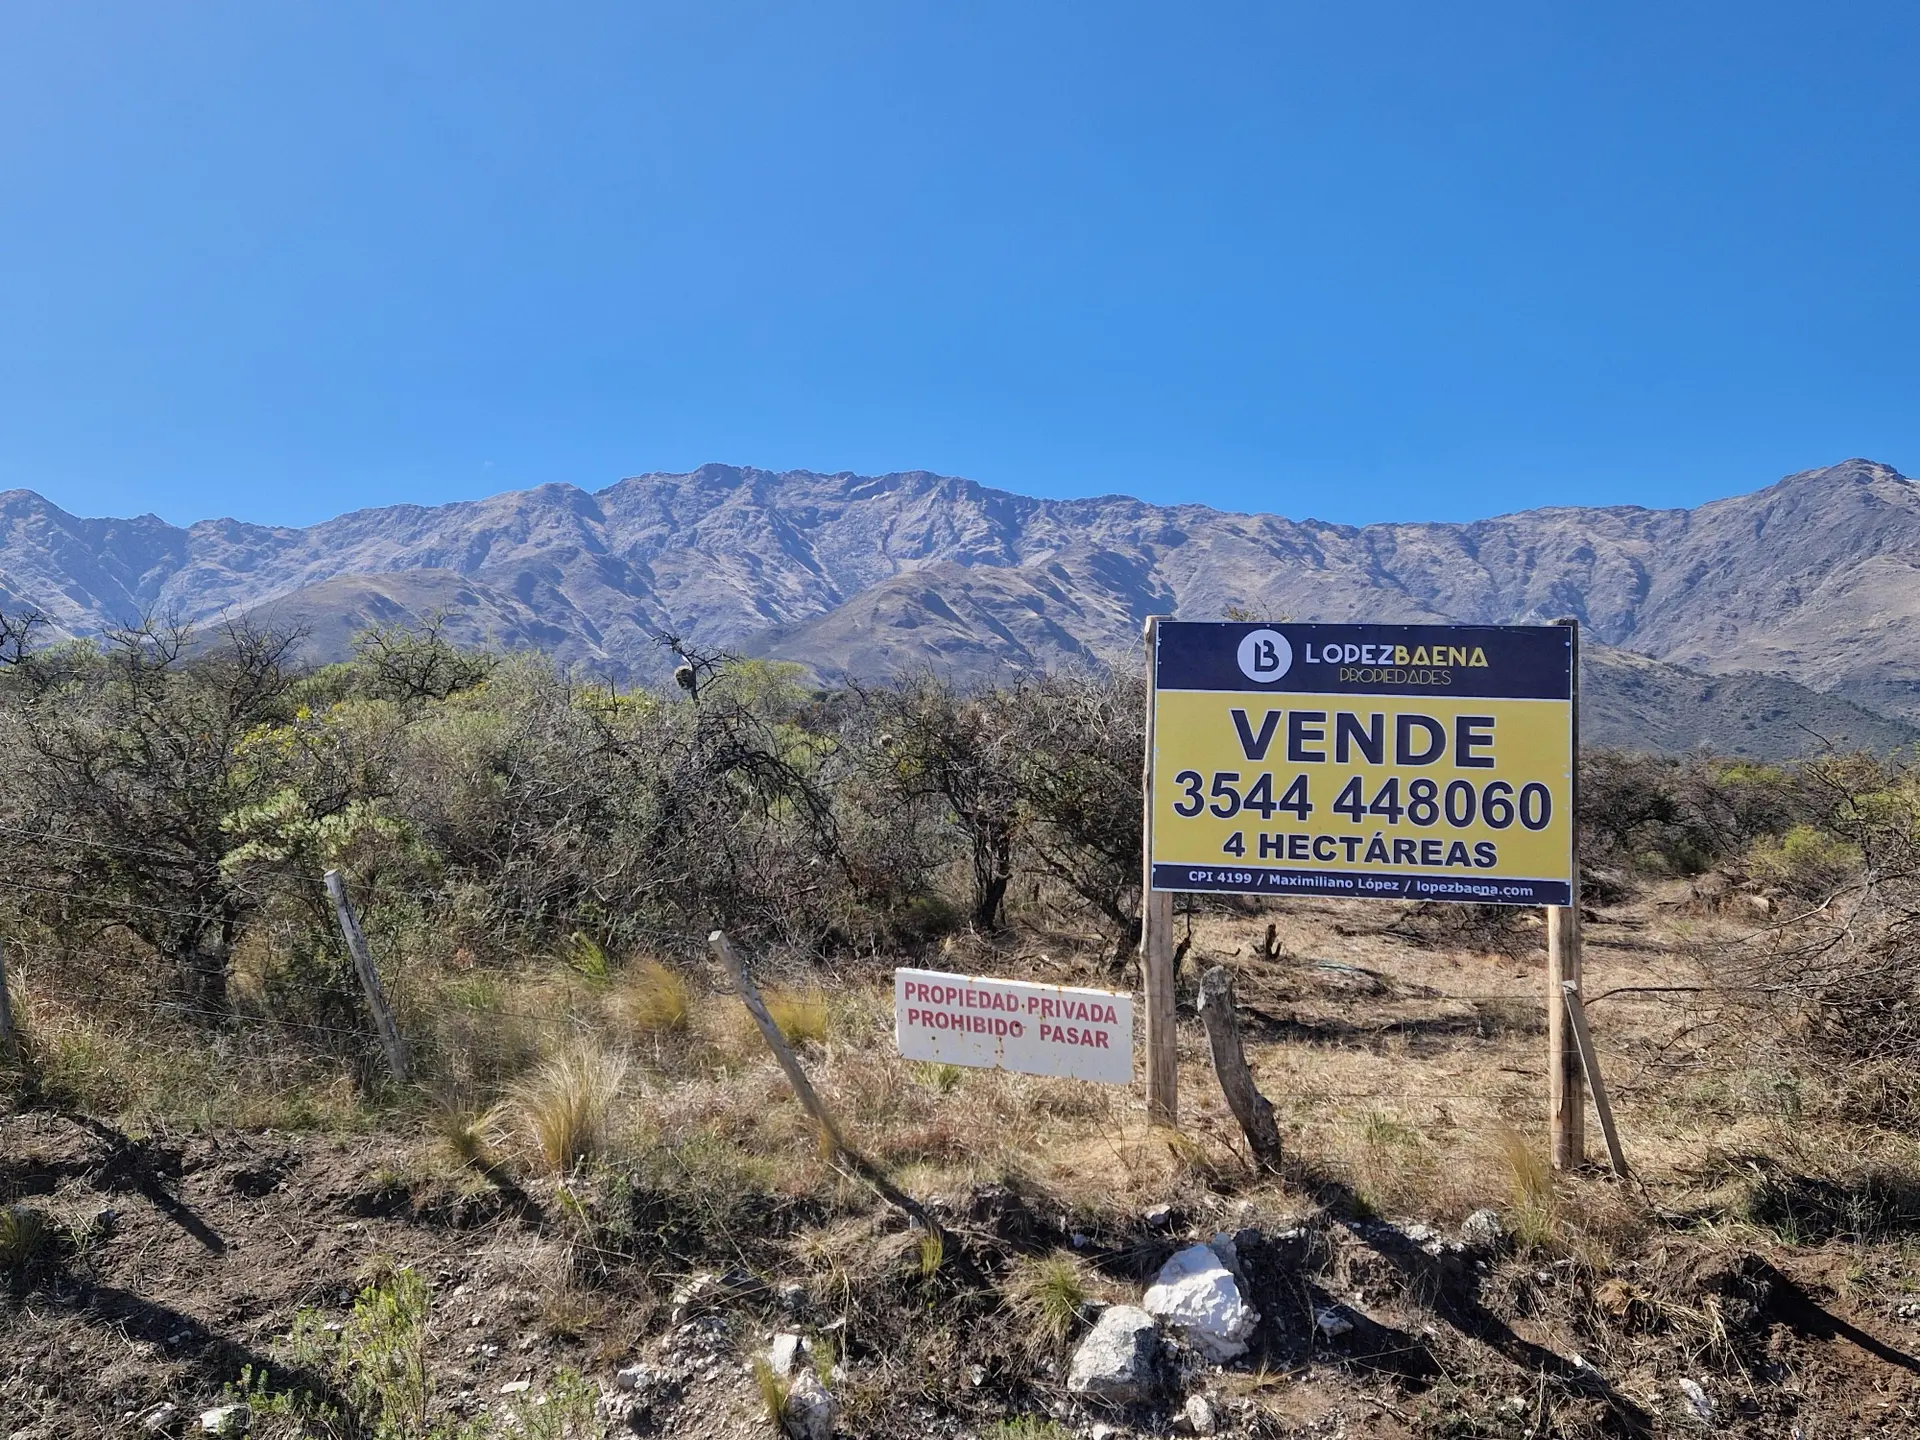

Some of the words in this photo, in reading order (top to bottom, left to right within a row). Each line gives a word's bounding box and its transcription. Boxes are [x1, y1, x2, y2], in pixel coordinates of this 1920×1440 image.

[1305, 643, 1489, 668] LOPEZBAENA
[1339, 667, 1452, 686] PROPIEDADES
[1229, 708, 1497, 769] VENDE
[1173, 770, 1313, 821] 3544
[1332, 775, 1552, 831] 448060
[1223, 832, 1245, 858] 4
[1259, 832, 1498, 869] HECTÁREAS
[1188, 871, 1213, 883] CPI
[1217, 871, 1252, 885] 4199
[1269, 874, 1354, 889] Maximiliano
[1358, 876, 1399, 893] López
[1416, 880, 1534, 898] lopezbaena.com
[904, 981, 1020, 1013] PROPIEDAD
[1027, 995, 1119, 1025] PRIVADA
[907, 1008, 1025, 1038] PROHIBIDO
[1039, 1023, 1110, 1049] PASAR
